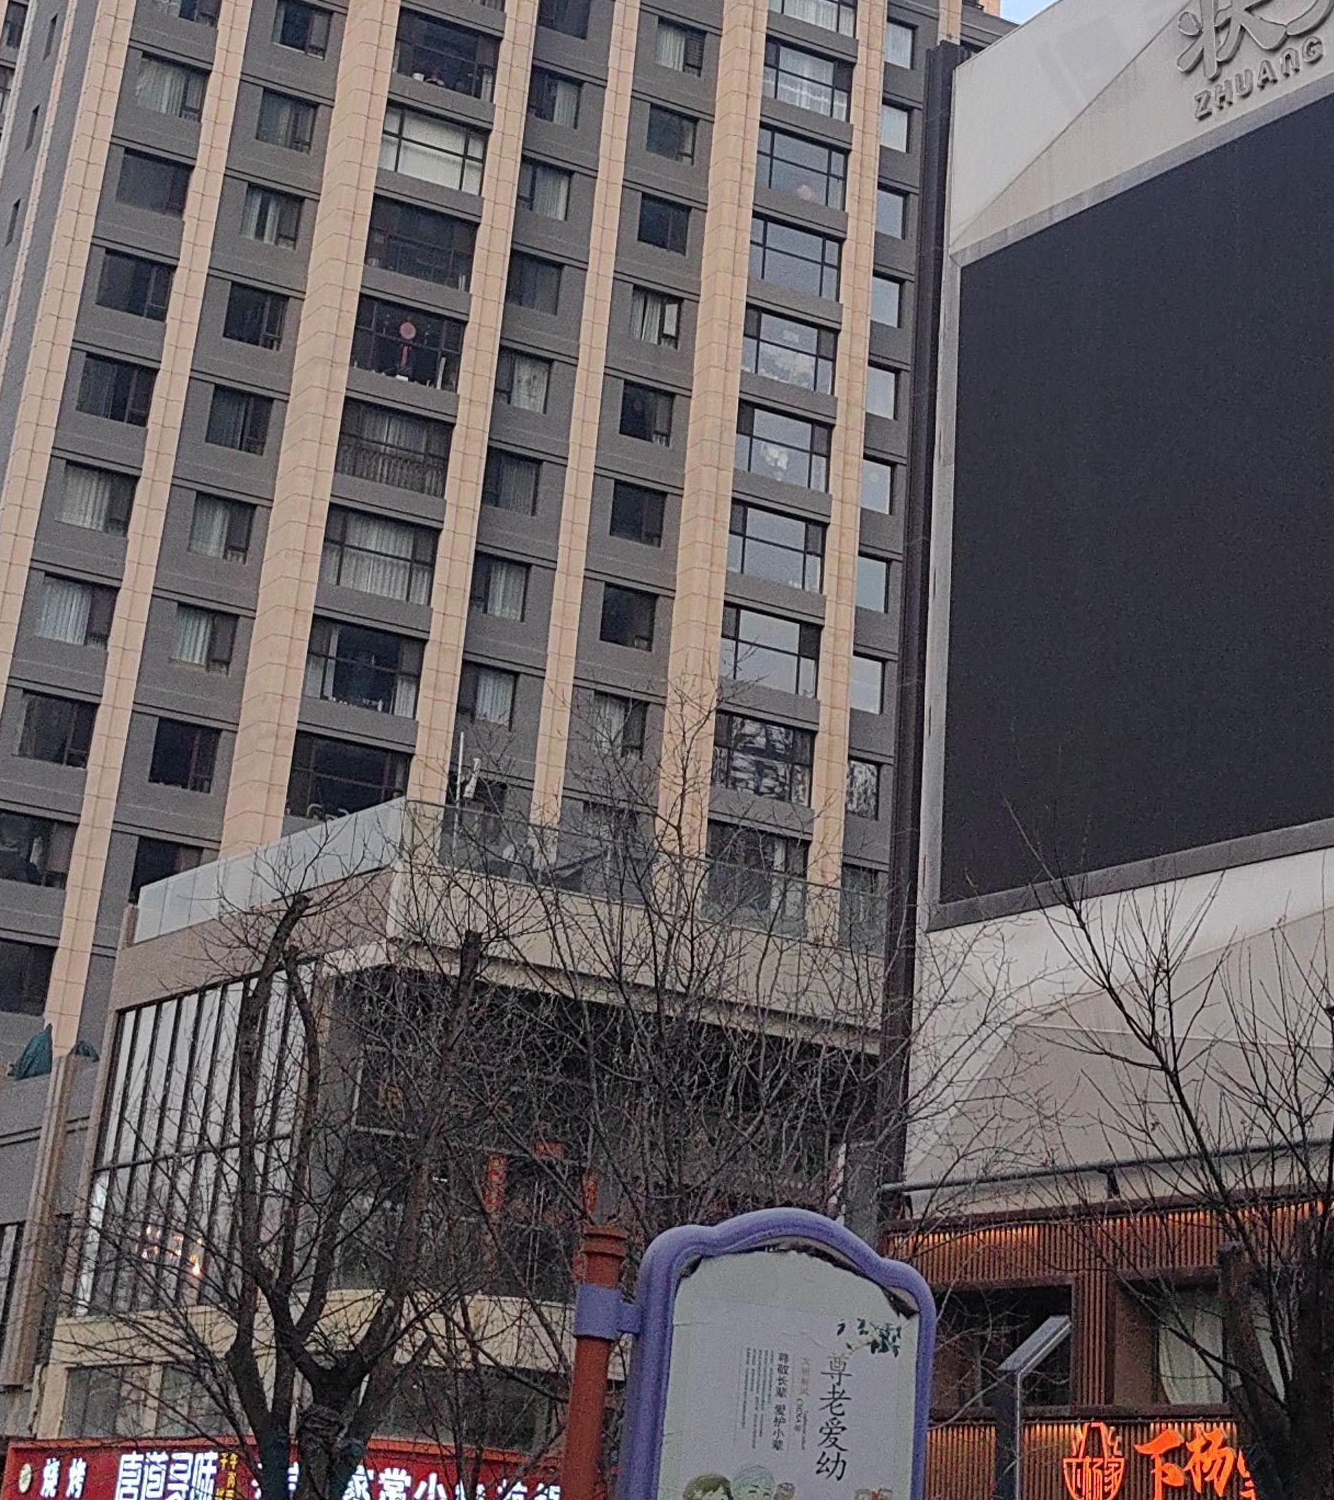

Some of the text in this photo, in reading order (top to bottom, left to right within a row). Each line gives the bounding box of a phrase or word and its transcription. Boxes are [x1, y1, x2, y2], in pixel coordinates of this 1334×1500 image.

[1192, 35, 1323, 121] ZHUANG
[816, 1350, 853, 1482] 尊老爱幼
[40, 1457, 88, 1498] 烧烤
